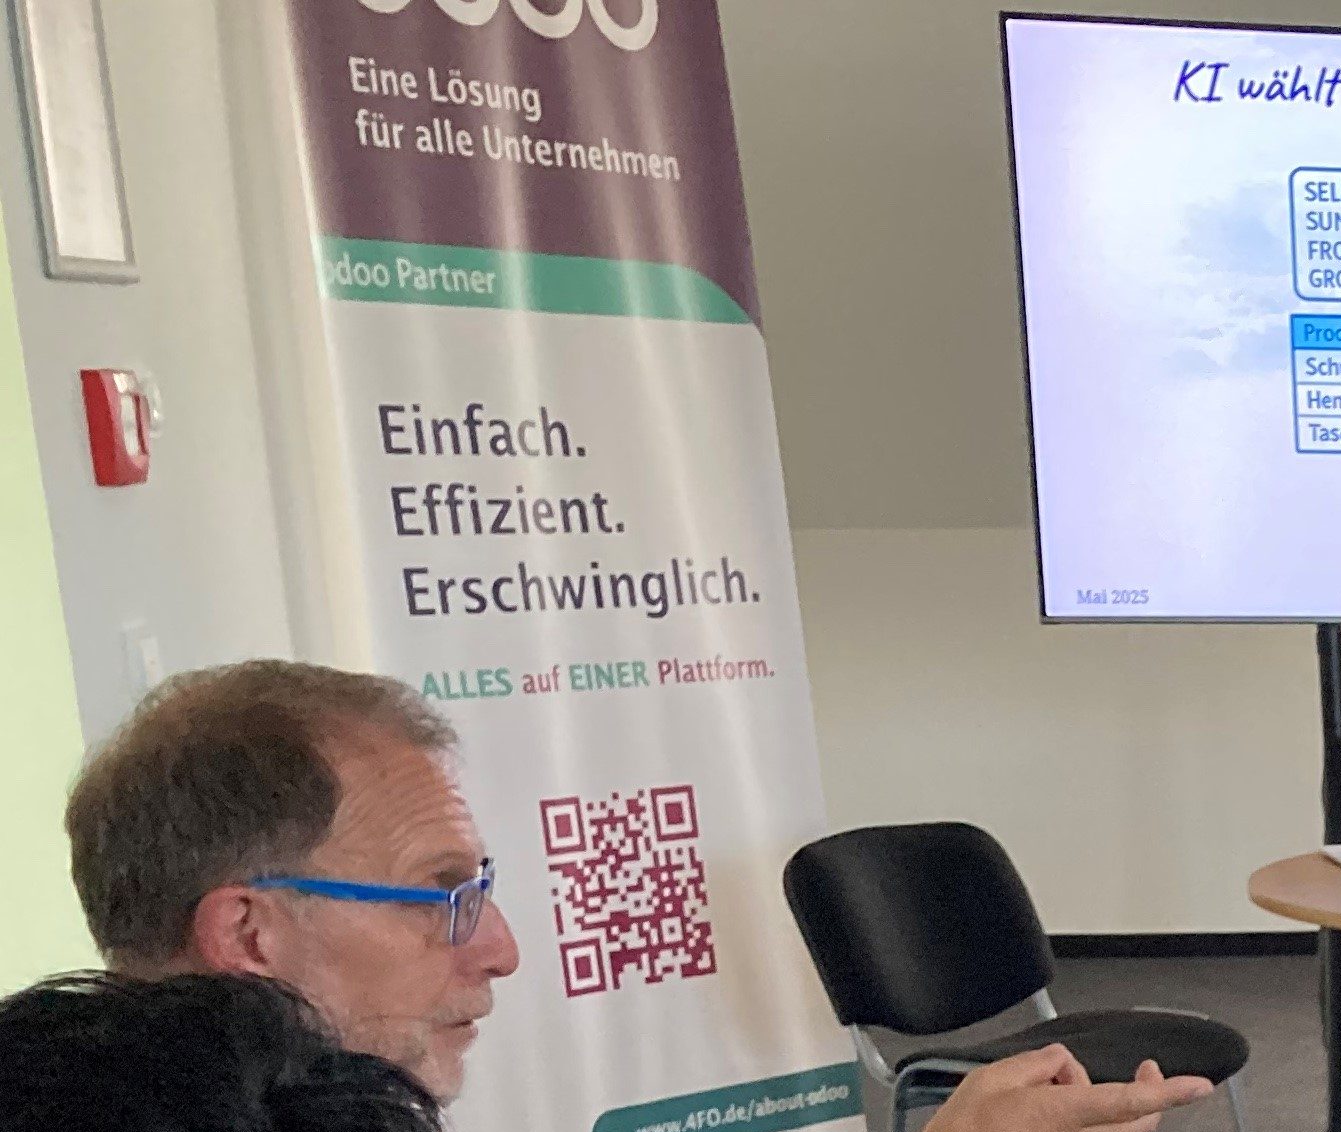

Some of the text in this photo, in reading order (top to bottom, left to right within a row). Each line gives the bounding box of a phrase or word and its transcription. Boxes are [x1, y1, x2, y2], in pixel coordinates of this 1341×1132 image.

[349, 56, 542, 121] Eine Lösung
[1174, 59, 1230, 103] KI
[355, 109, 681, 182] für alle Unternehmen
[395, 256, 496, 294] Partner
[379, 403, 586, 458] Einfach.
[390, 482, 625, 537] Effizient.
[403, 556, 761, 618] Erschwinglich.
[1077, 589, 1149, 604] Mai 2025
[421, 654, 776, 701] ALLES auf EINER Plattform.
